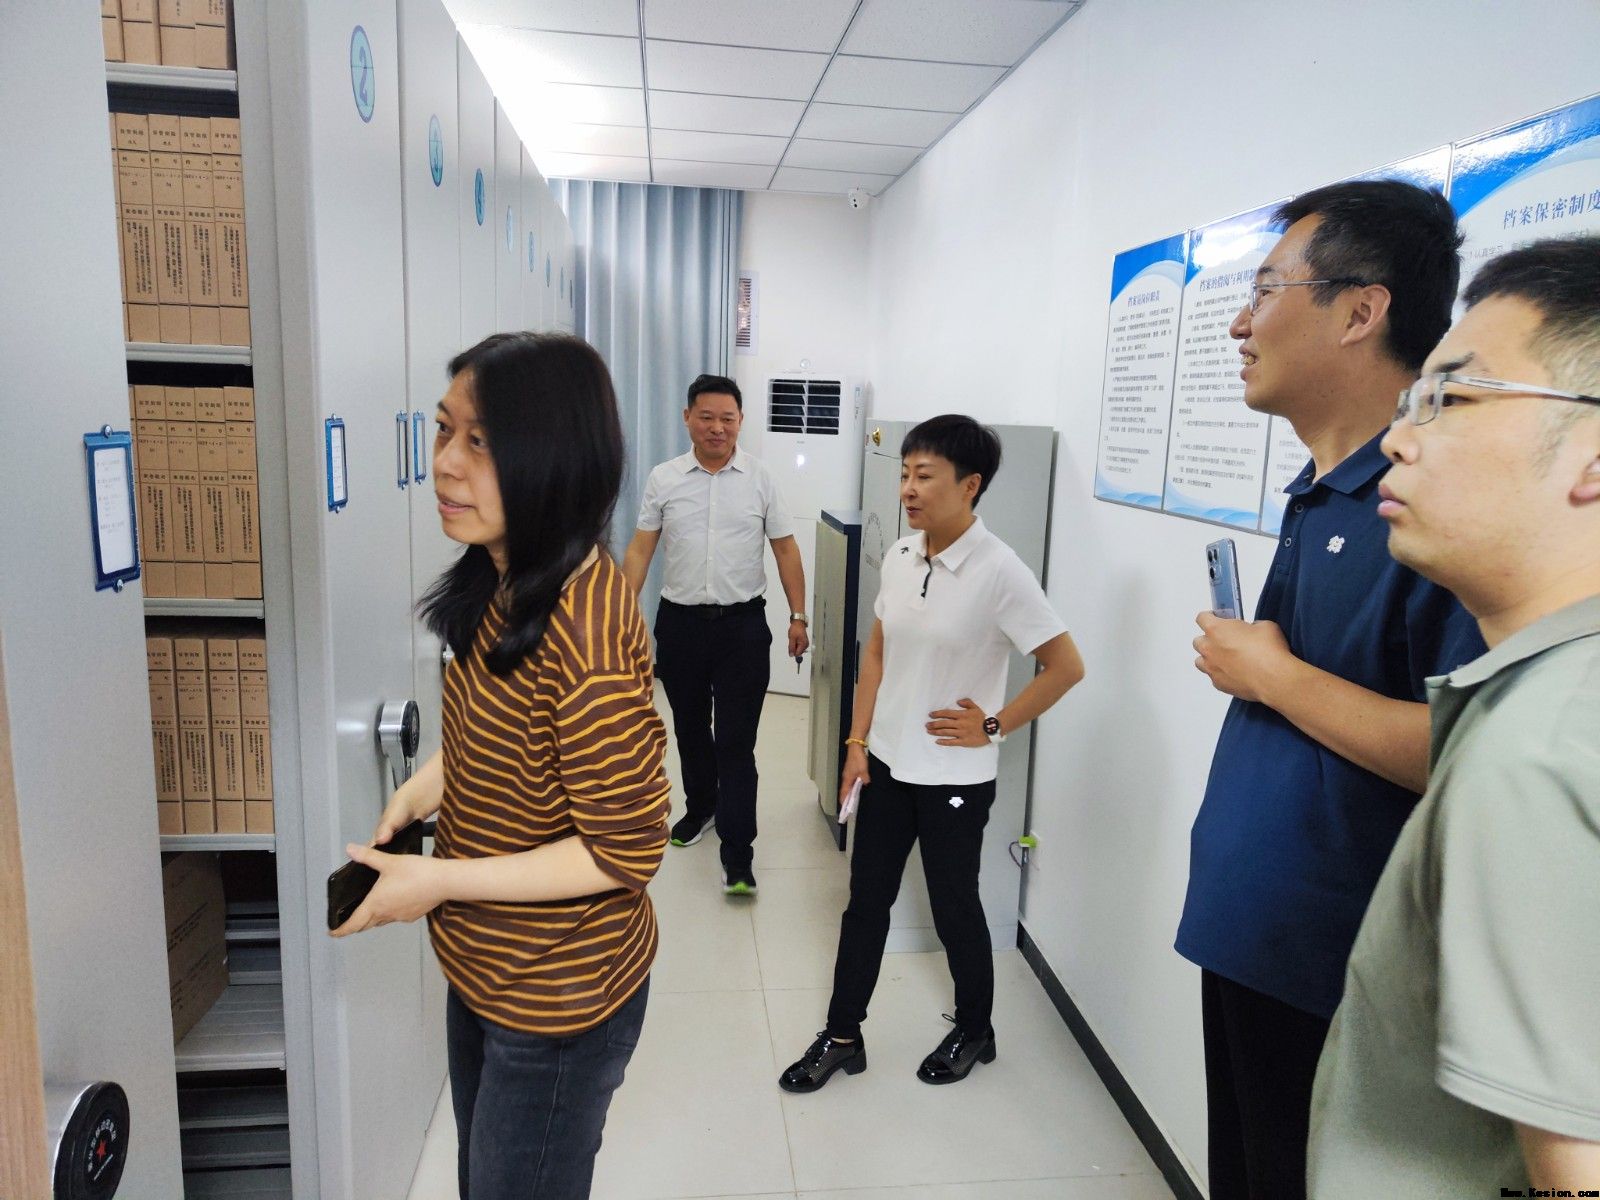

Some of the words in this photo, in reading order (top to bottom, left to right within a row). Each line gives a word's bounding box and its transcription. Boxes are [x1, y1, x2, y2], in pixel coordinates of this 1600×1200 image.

[358, 46, 368, 107] 2
[1503, 189, 1600, 230] 档案保密制度
